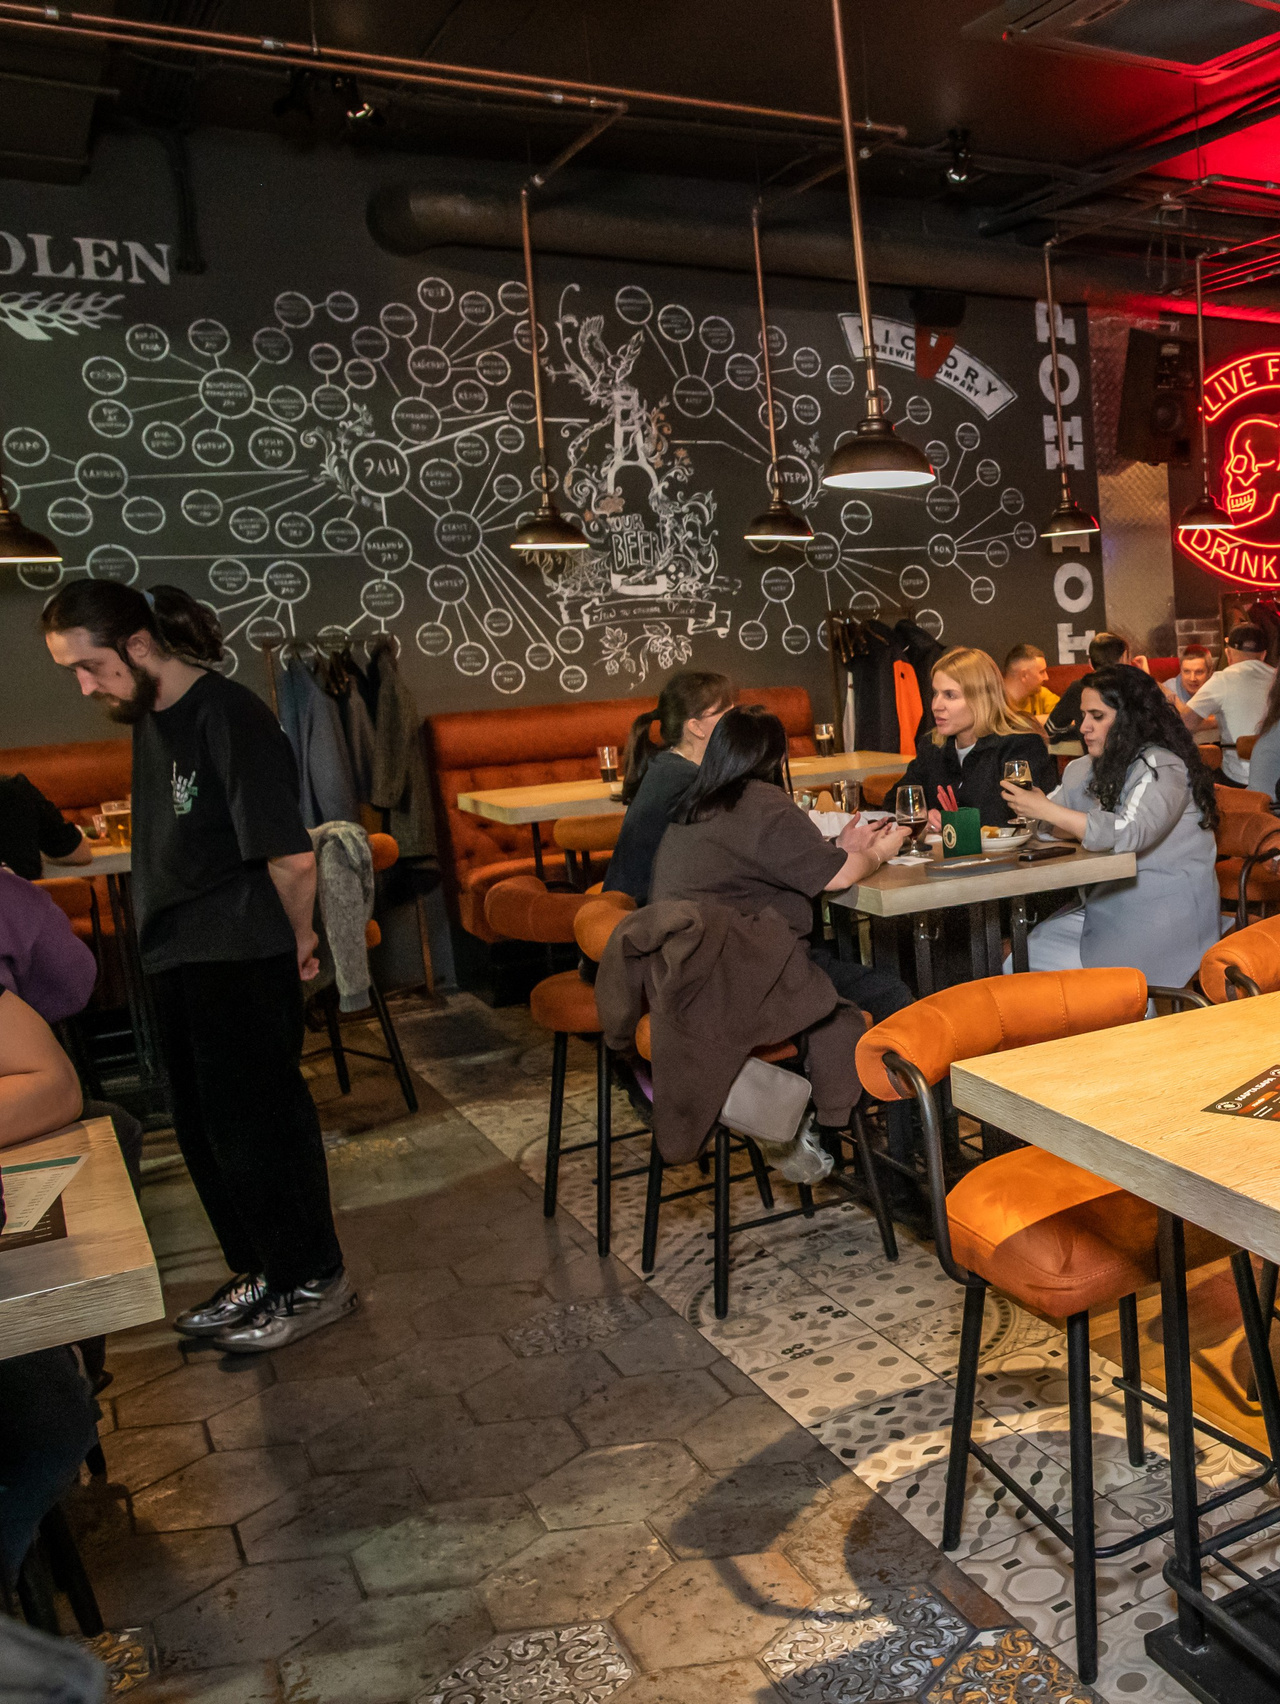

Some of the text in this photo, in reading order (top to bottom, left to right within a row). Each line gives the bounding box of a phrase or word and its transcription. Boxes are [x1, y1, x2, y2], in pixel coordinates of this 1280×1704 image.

[858, 325, 998, 397] ICORY
[1035, 300, 1085, 470] HOP
[1203, 362, 1258, 412] LIVE
[363, 457, 400, 477] ЭЛИ
[771, 471, 808, 483] ГЕРЫ
[1190, 528, 1278, 580] DRINK
